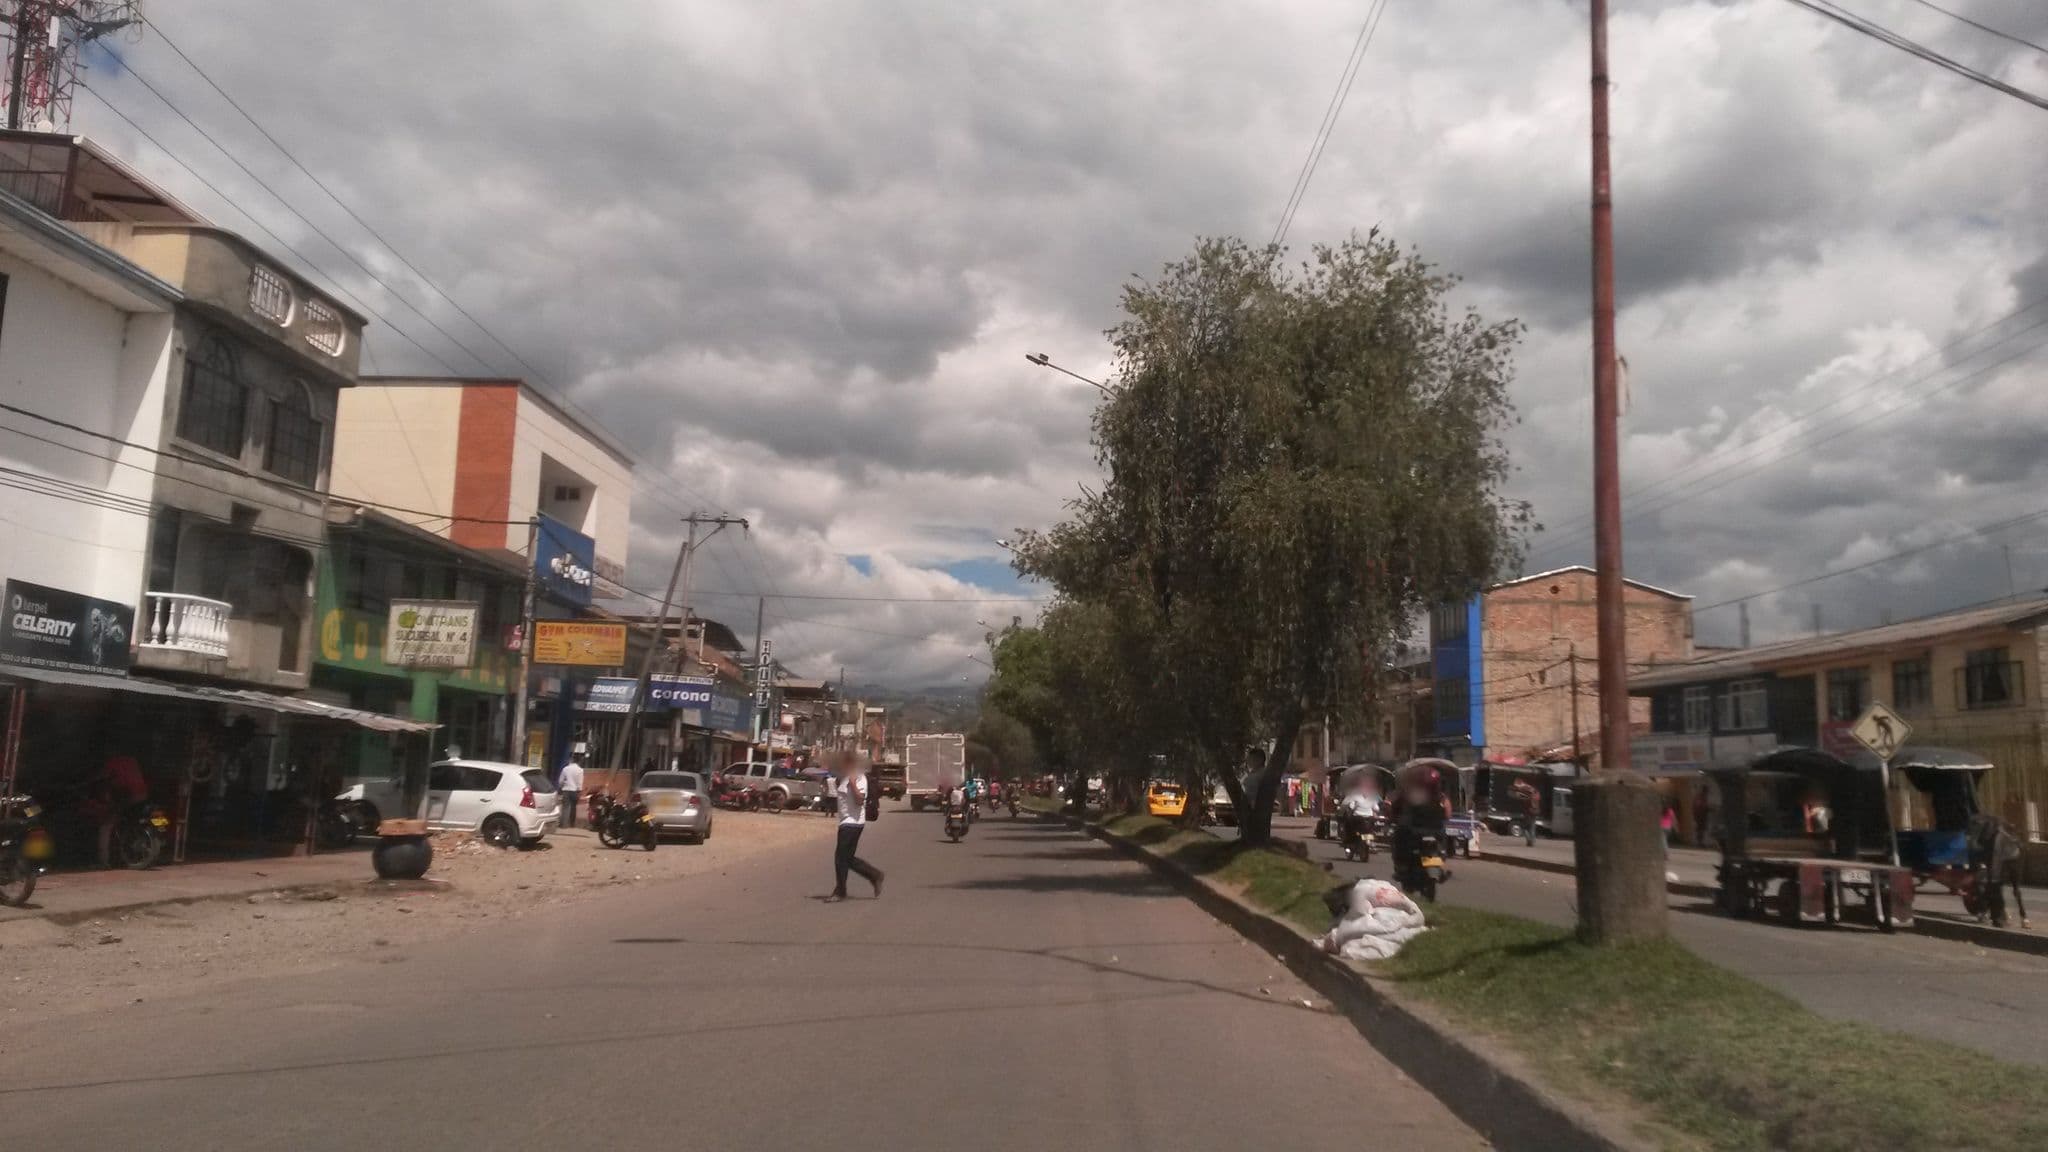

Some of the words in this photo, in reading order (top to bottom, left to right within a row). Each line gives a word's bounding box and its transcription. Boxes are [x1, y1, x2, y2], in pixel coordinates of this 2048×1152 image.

[13, 613, 76, 638] CELERITY
[539, 624, 564, 638] GYM
[459, 631, 468, 643] 4
[652, 688, 711, 702] corona
[600, 704, 628, 712] MOTOS
